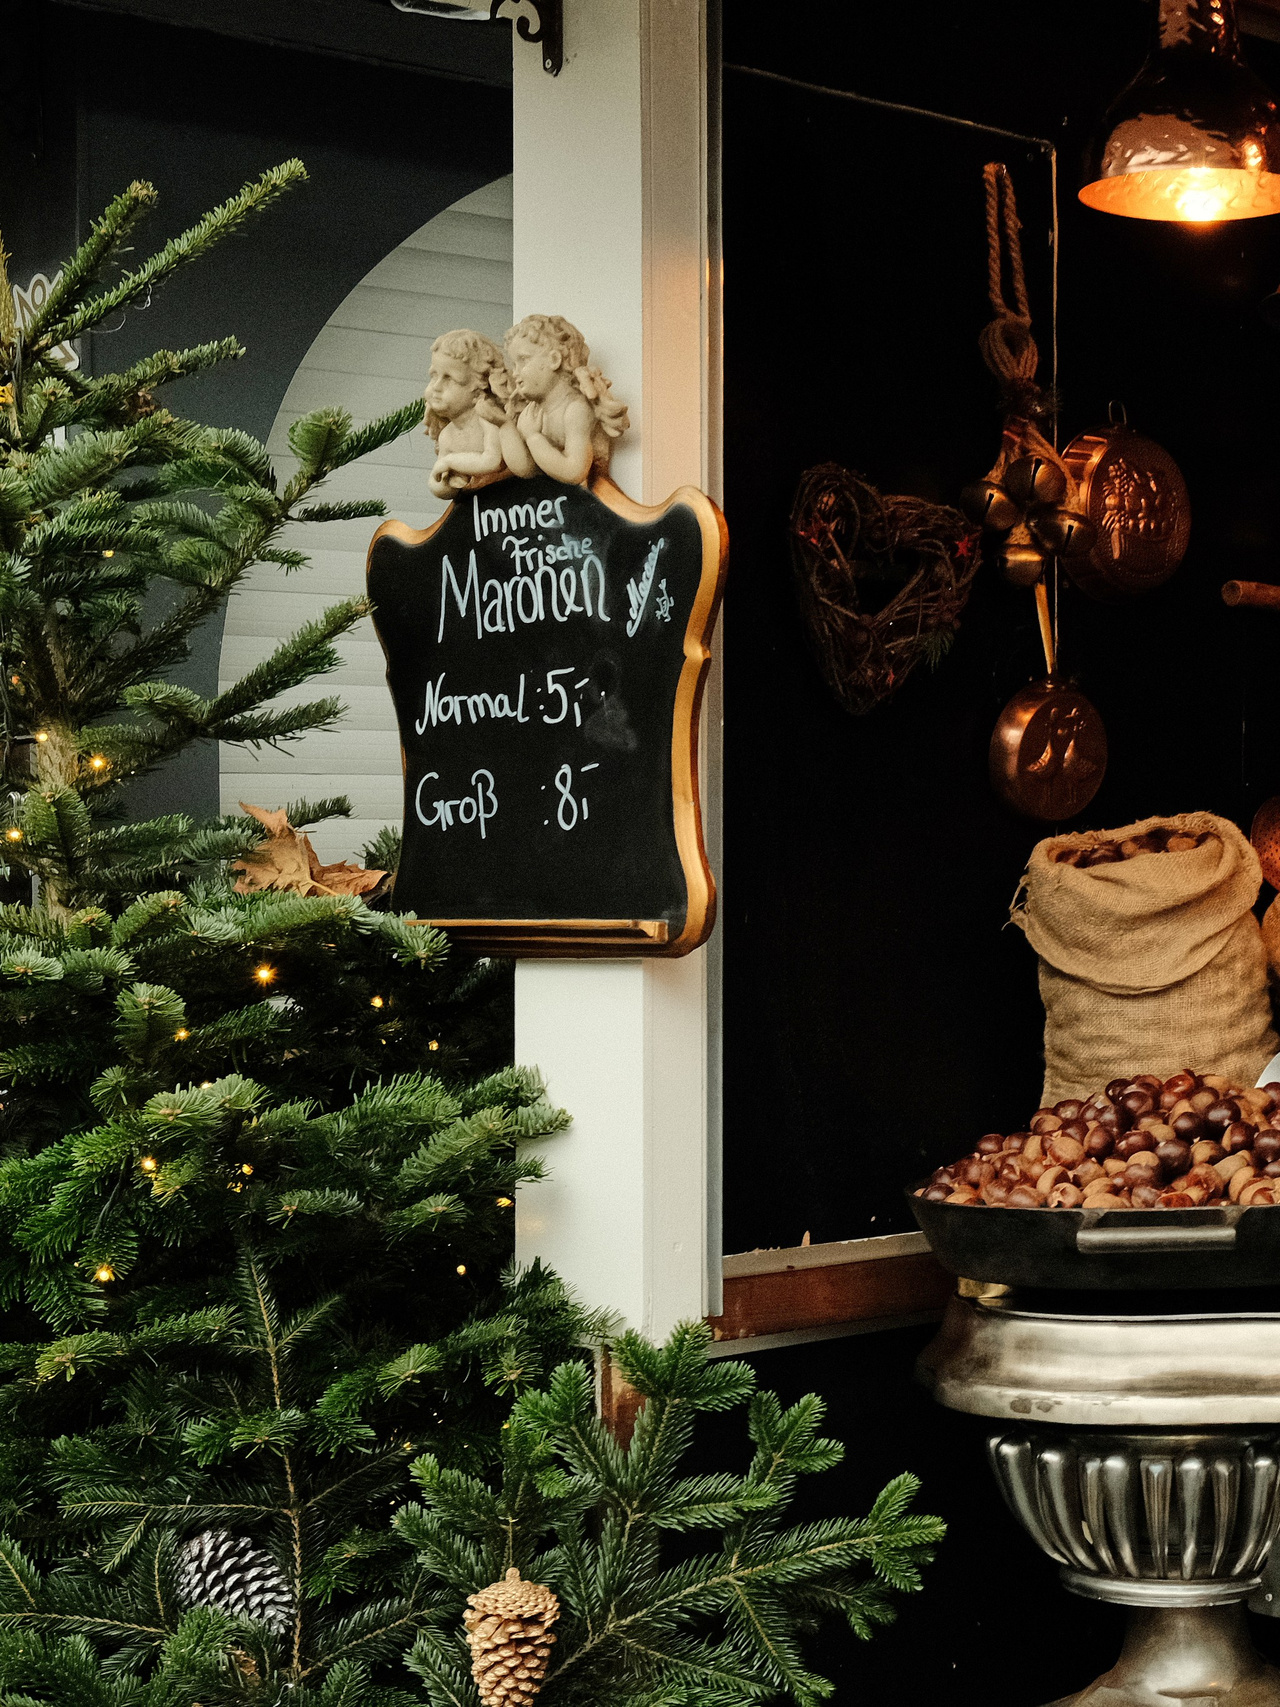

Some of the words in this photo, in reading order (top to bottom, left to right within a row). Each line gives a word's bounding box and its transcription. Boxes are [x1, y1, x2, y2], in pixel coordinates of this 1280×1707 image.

[473, 495, 568, 541] Immer
[502, 533, 594, 576] Frische
[437, 549, 611, 644] Maronen
[415, 673, 530, 736] Normal
[415, 769, 499, 839] Groß
